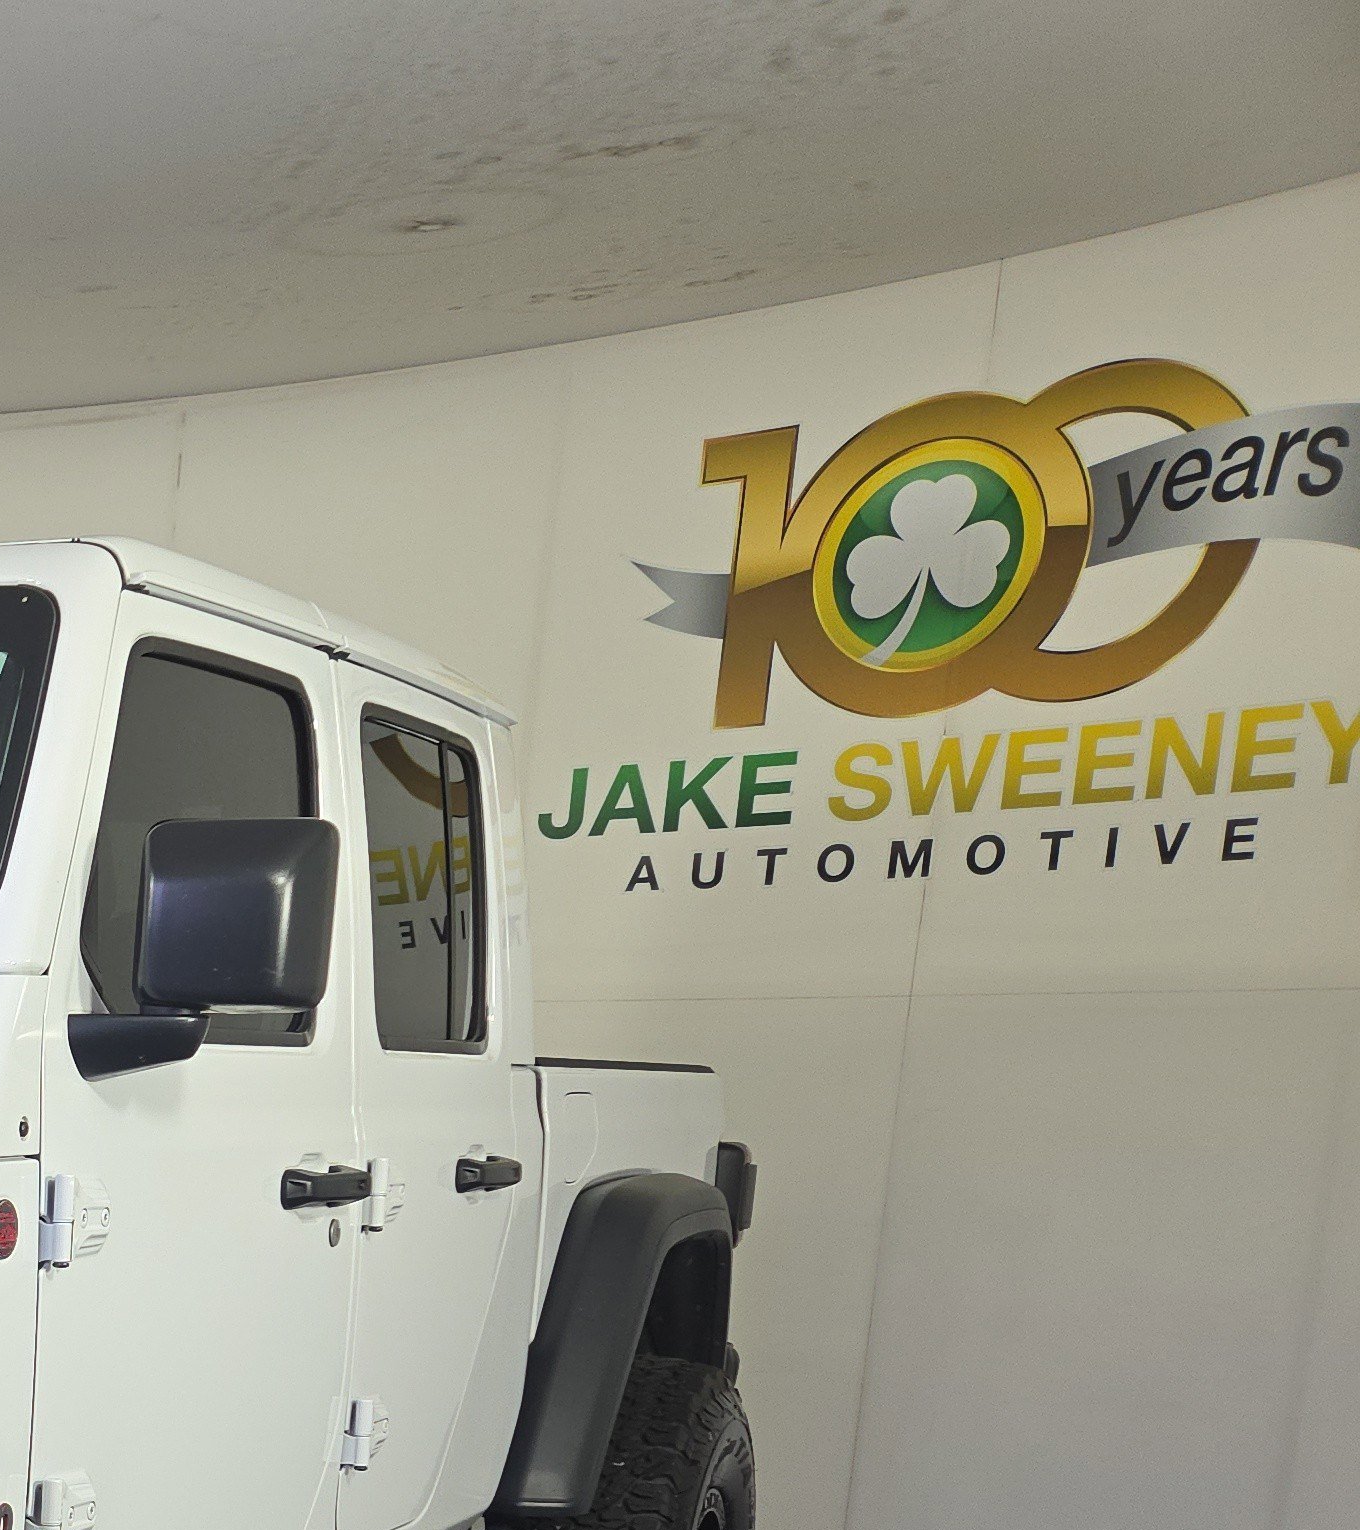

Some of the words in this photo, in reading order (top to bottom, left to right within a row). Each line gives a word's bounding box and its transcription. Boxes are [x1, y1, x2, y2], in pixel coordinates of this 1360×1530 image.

[1106, 425, 1349, 548] years
[538, 751, 798, 841] JAKE
[829, 699, 1360, 822] SWEENEY
[625, 818, 1260, 893] AUTOMOTIVE
